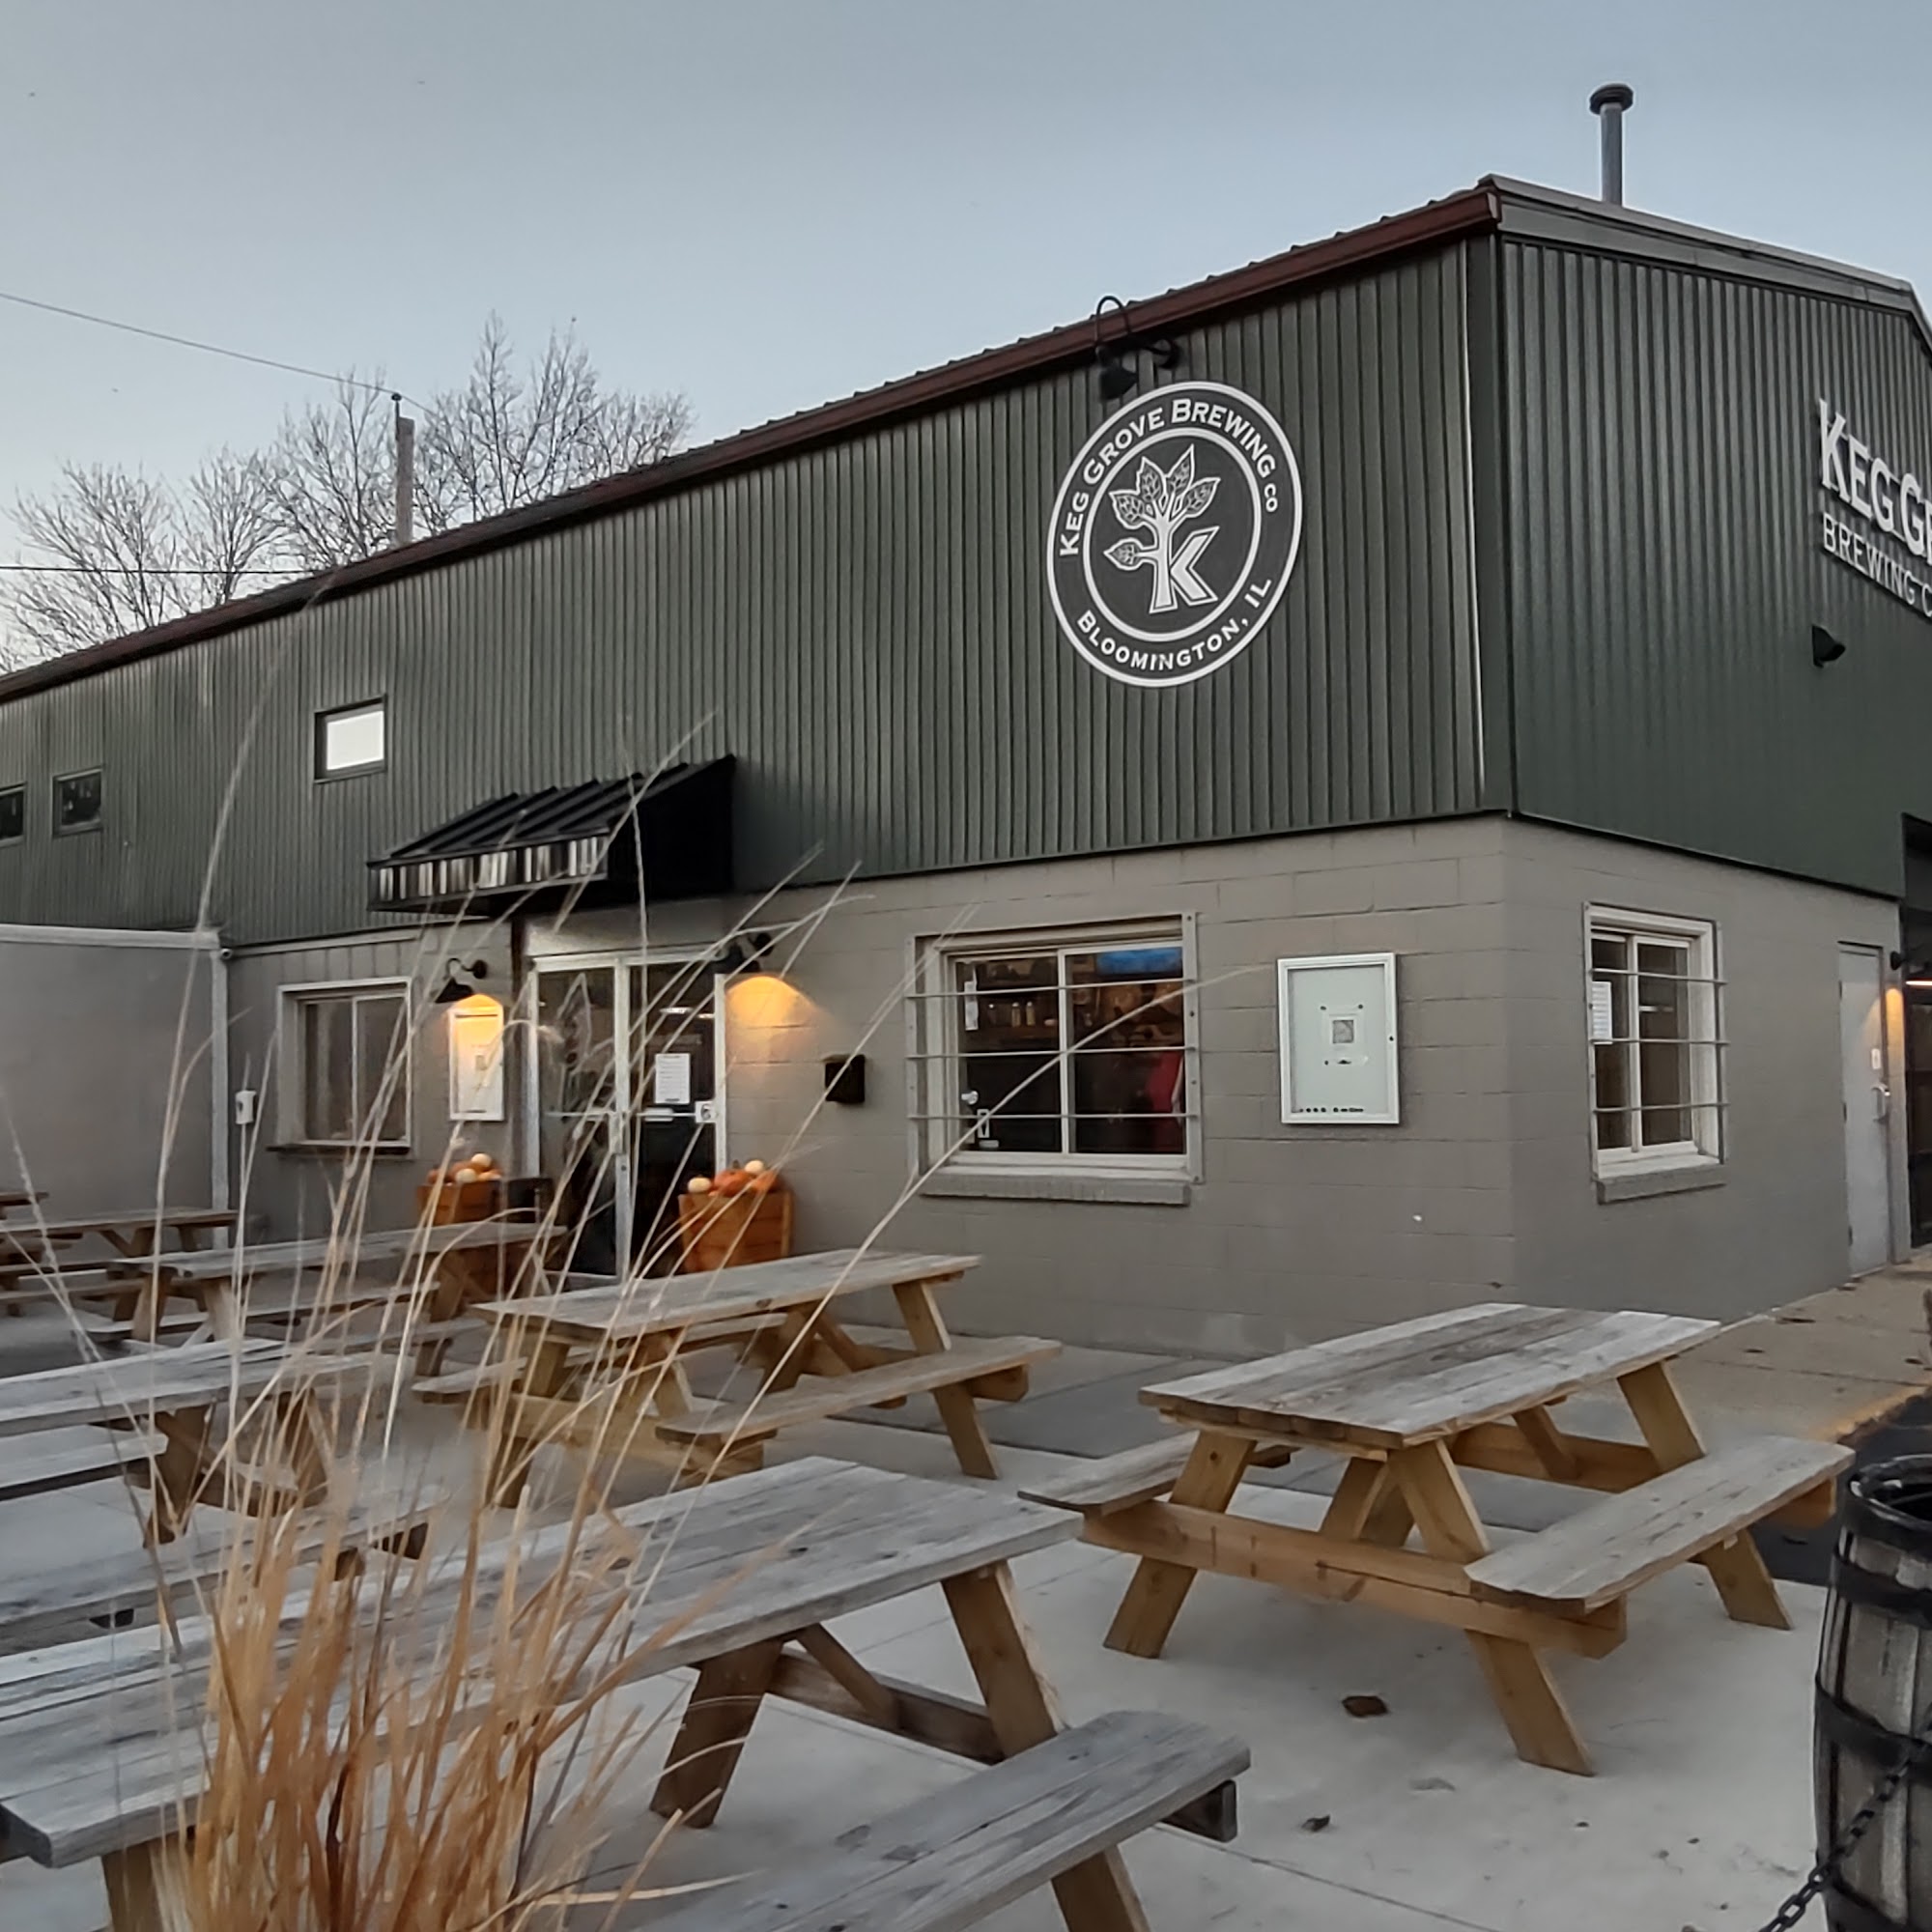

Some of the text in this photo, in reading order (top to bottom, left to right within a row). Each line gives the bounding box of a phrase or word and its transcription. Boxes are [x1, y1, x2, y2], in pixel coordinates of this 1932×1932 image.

[1061, 398, 1278, 556] KEG GROVE BREWING CO
[1819, 397, 1893, 532] KEG
[1823, 512, 1916, 605] BREWING
[1077, 580, 1272, 670] BLOOMINGTON, IL
